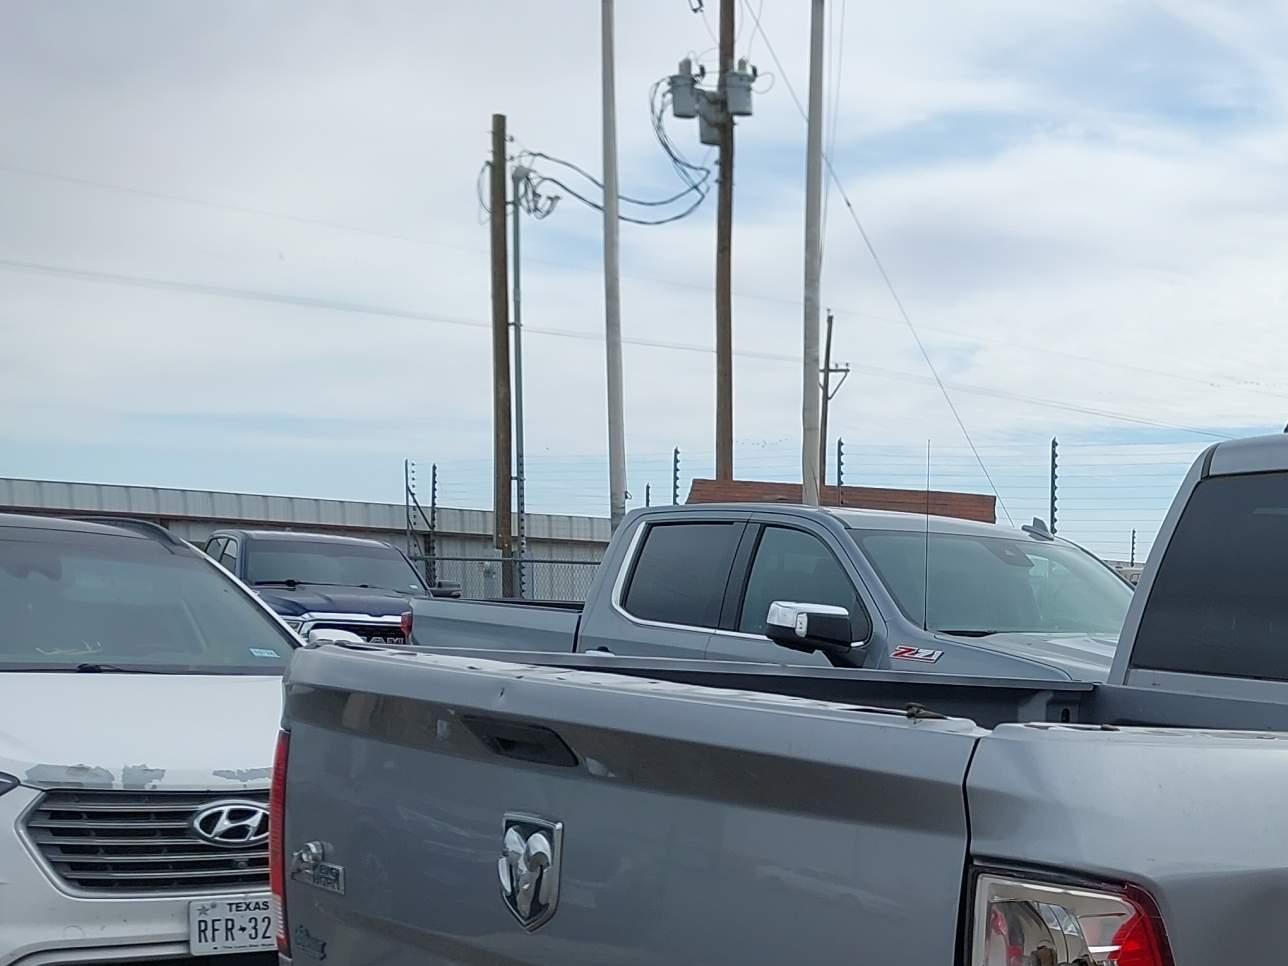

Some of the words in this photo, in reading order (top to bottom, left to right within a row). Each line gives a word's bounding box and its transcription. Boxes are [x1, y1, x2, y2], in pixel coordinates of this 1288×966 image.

[360, 636, 404, 645] AM
[890, 646, 944, 663] Z71
[226, 901, 269, 913] TEXAS
